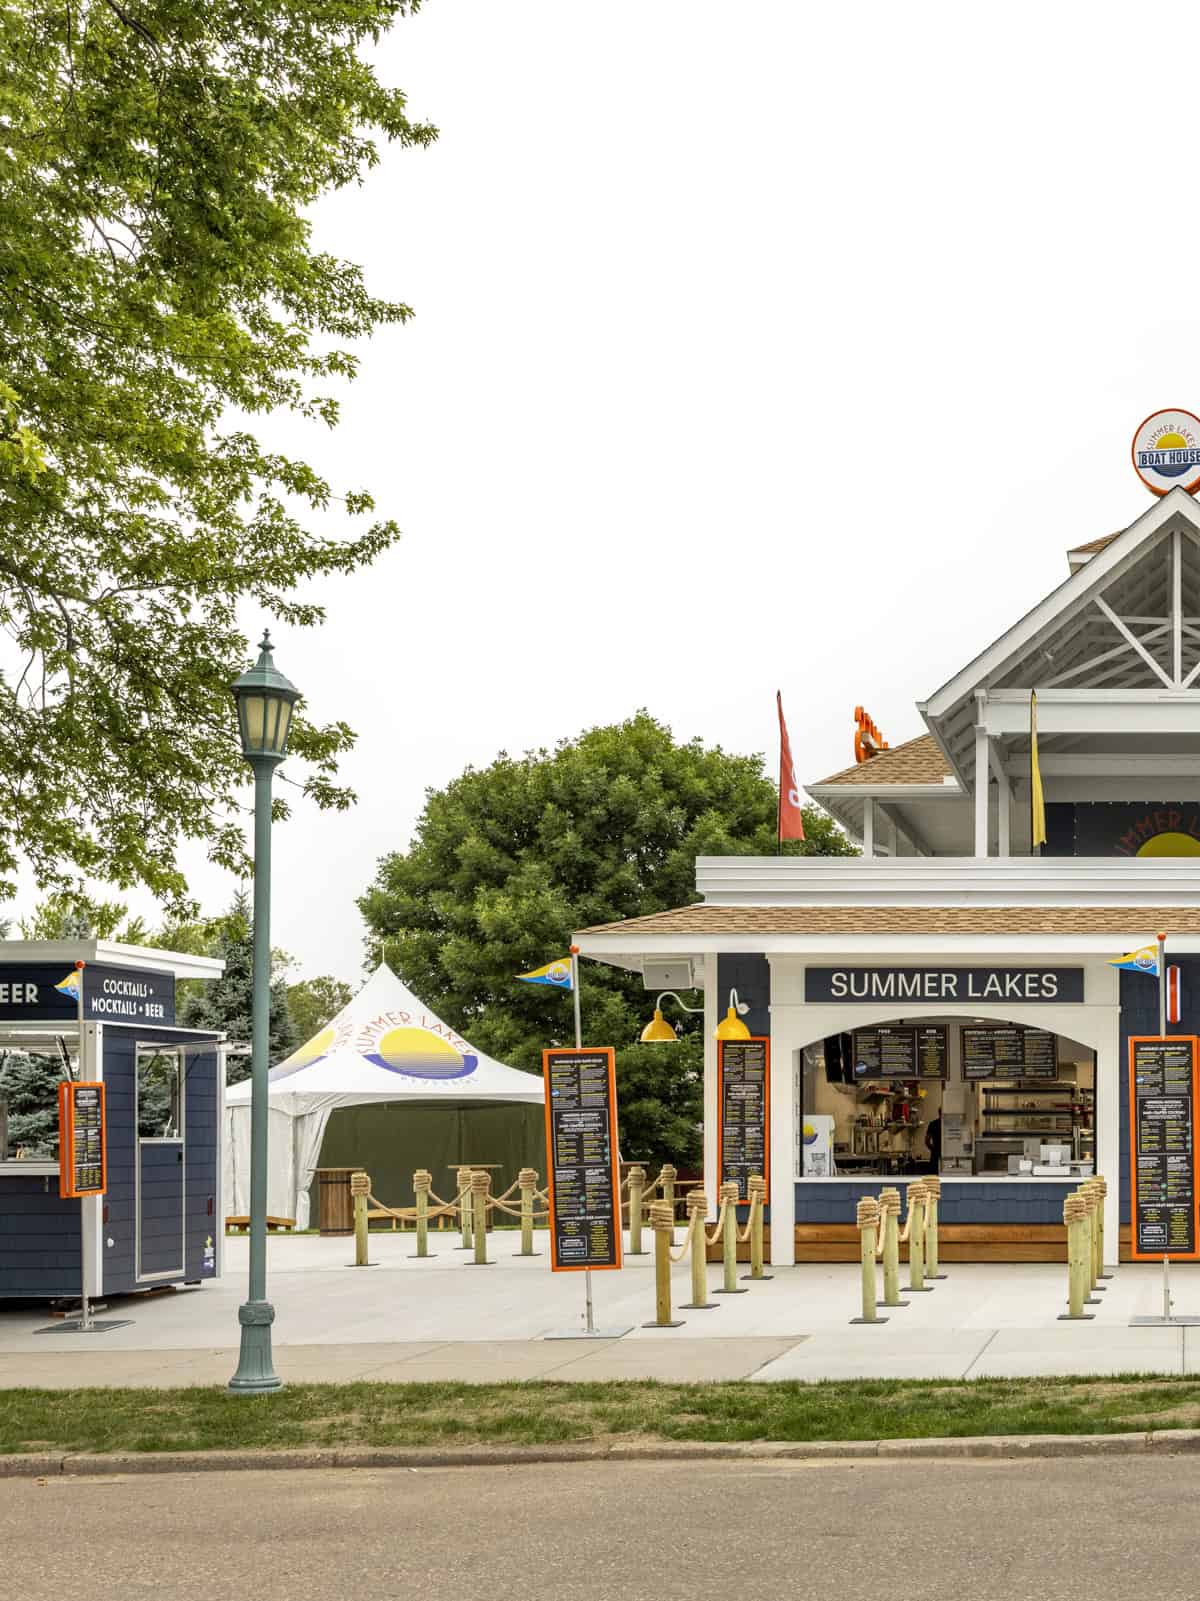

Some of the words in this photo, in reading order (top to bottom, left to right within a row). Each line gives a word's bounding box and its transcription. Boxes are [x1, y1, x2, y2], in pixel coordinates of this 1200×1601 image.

[1146, 424, 1174, 450] SUMMER
[1176, 426, 1197, 449] LAKES
[1141, 453, 1166, 465] BOAT
[1169, 450, 1200, 464] HOUSE
[1113, 810, 1183, 857] UMMER
[0, 983, 39, 1003] EER
[103, 979, 148, 998] COCKTAILS
[831, 972, 957, 997] SUMMER
[968, 973, 1058, 997] LAKES
[91, 998, 137, 1016] MOCKTAILS
[145, 1003, 165, 1018] BEER
[354, 1011, 412, 1055] SUMMER
[420, 1015, 476, 1055] LAKES
